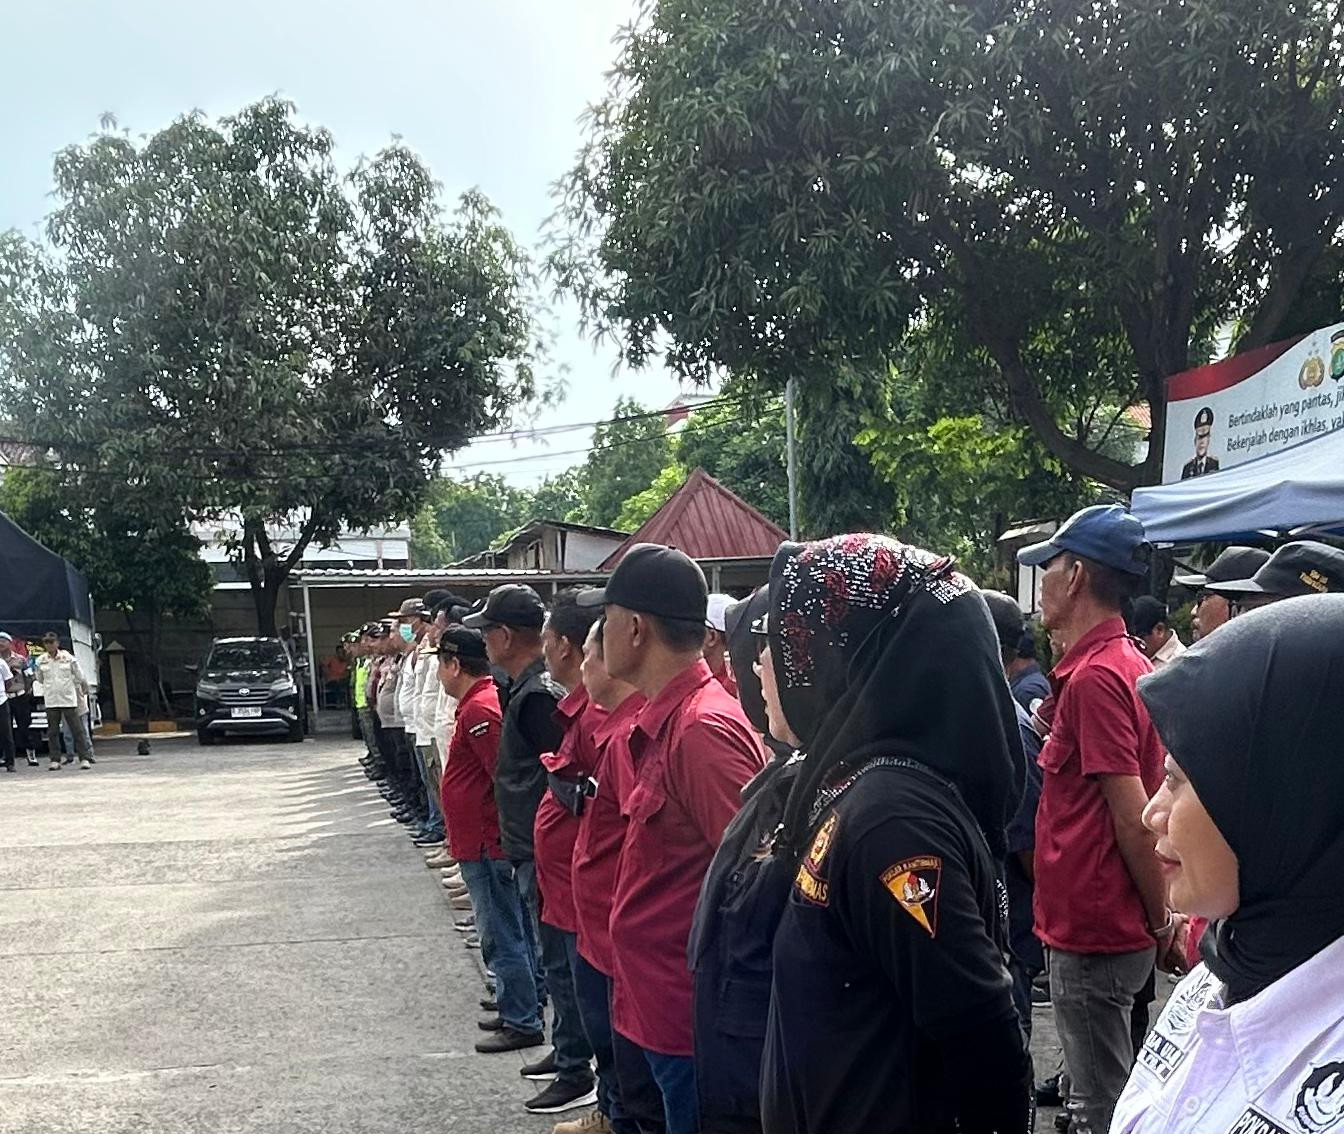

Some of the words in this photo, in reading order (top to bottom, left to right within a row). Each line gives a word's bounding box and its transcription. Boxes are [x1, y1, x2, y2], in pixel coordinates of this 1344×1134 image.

[1227, 402, 1278, 429] Bertindaklah
[1278, 400, 1301, 421] yang
[1300, 391, 1334, 414] pantas,
[1226, 431, 1268, 452] Bekerjalah
[1268, 424, 1301, 445] dengan
